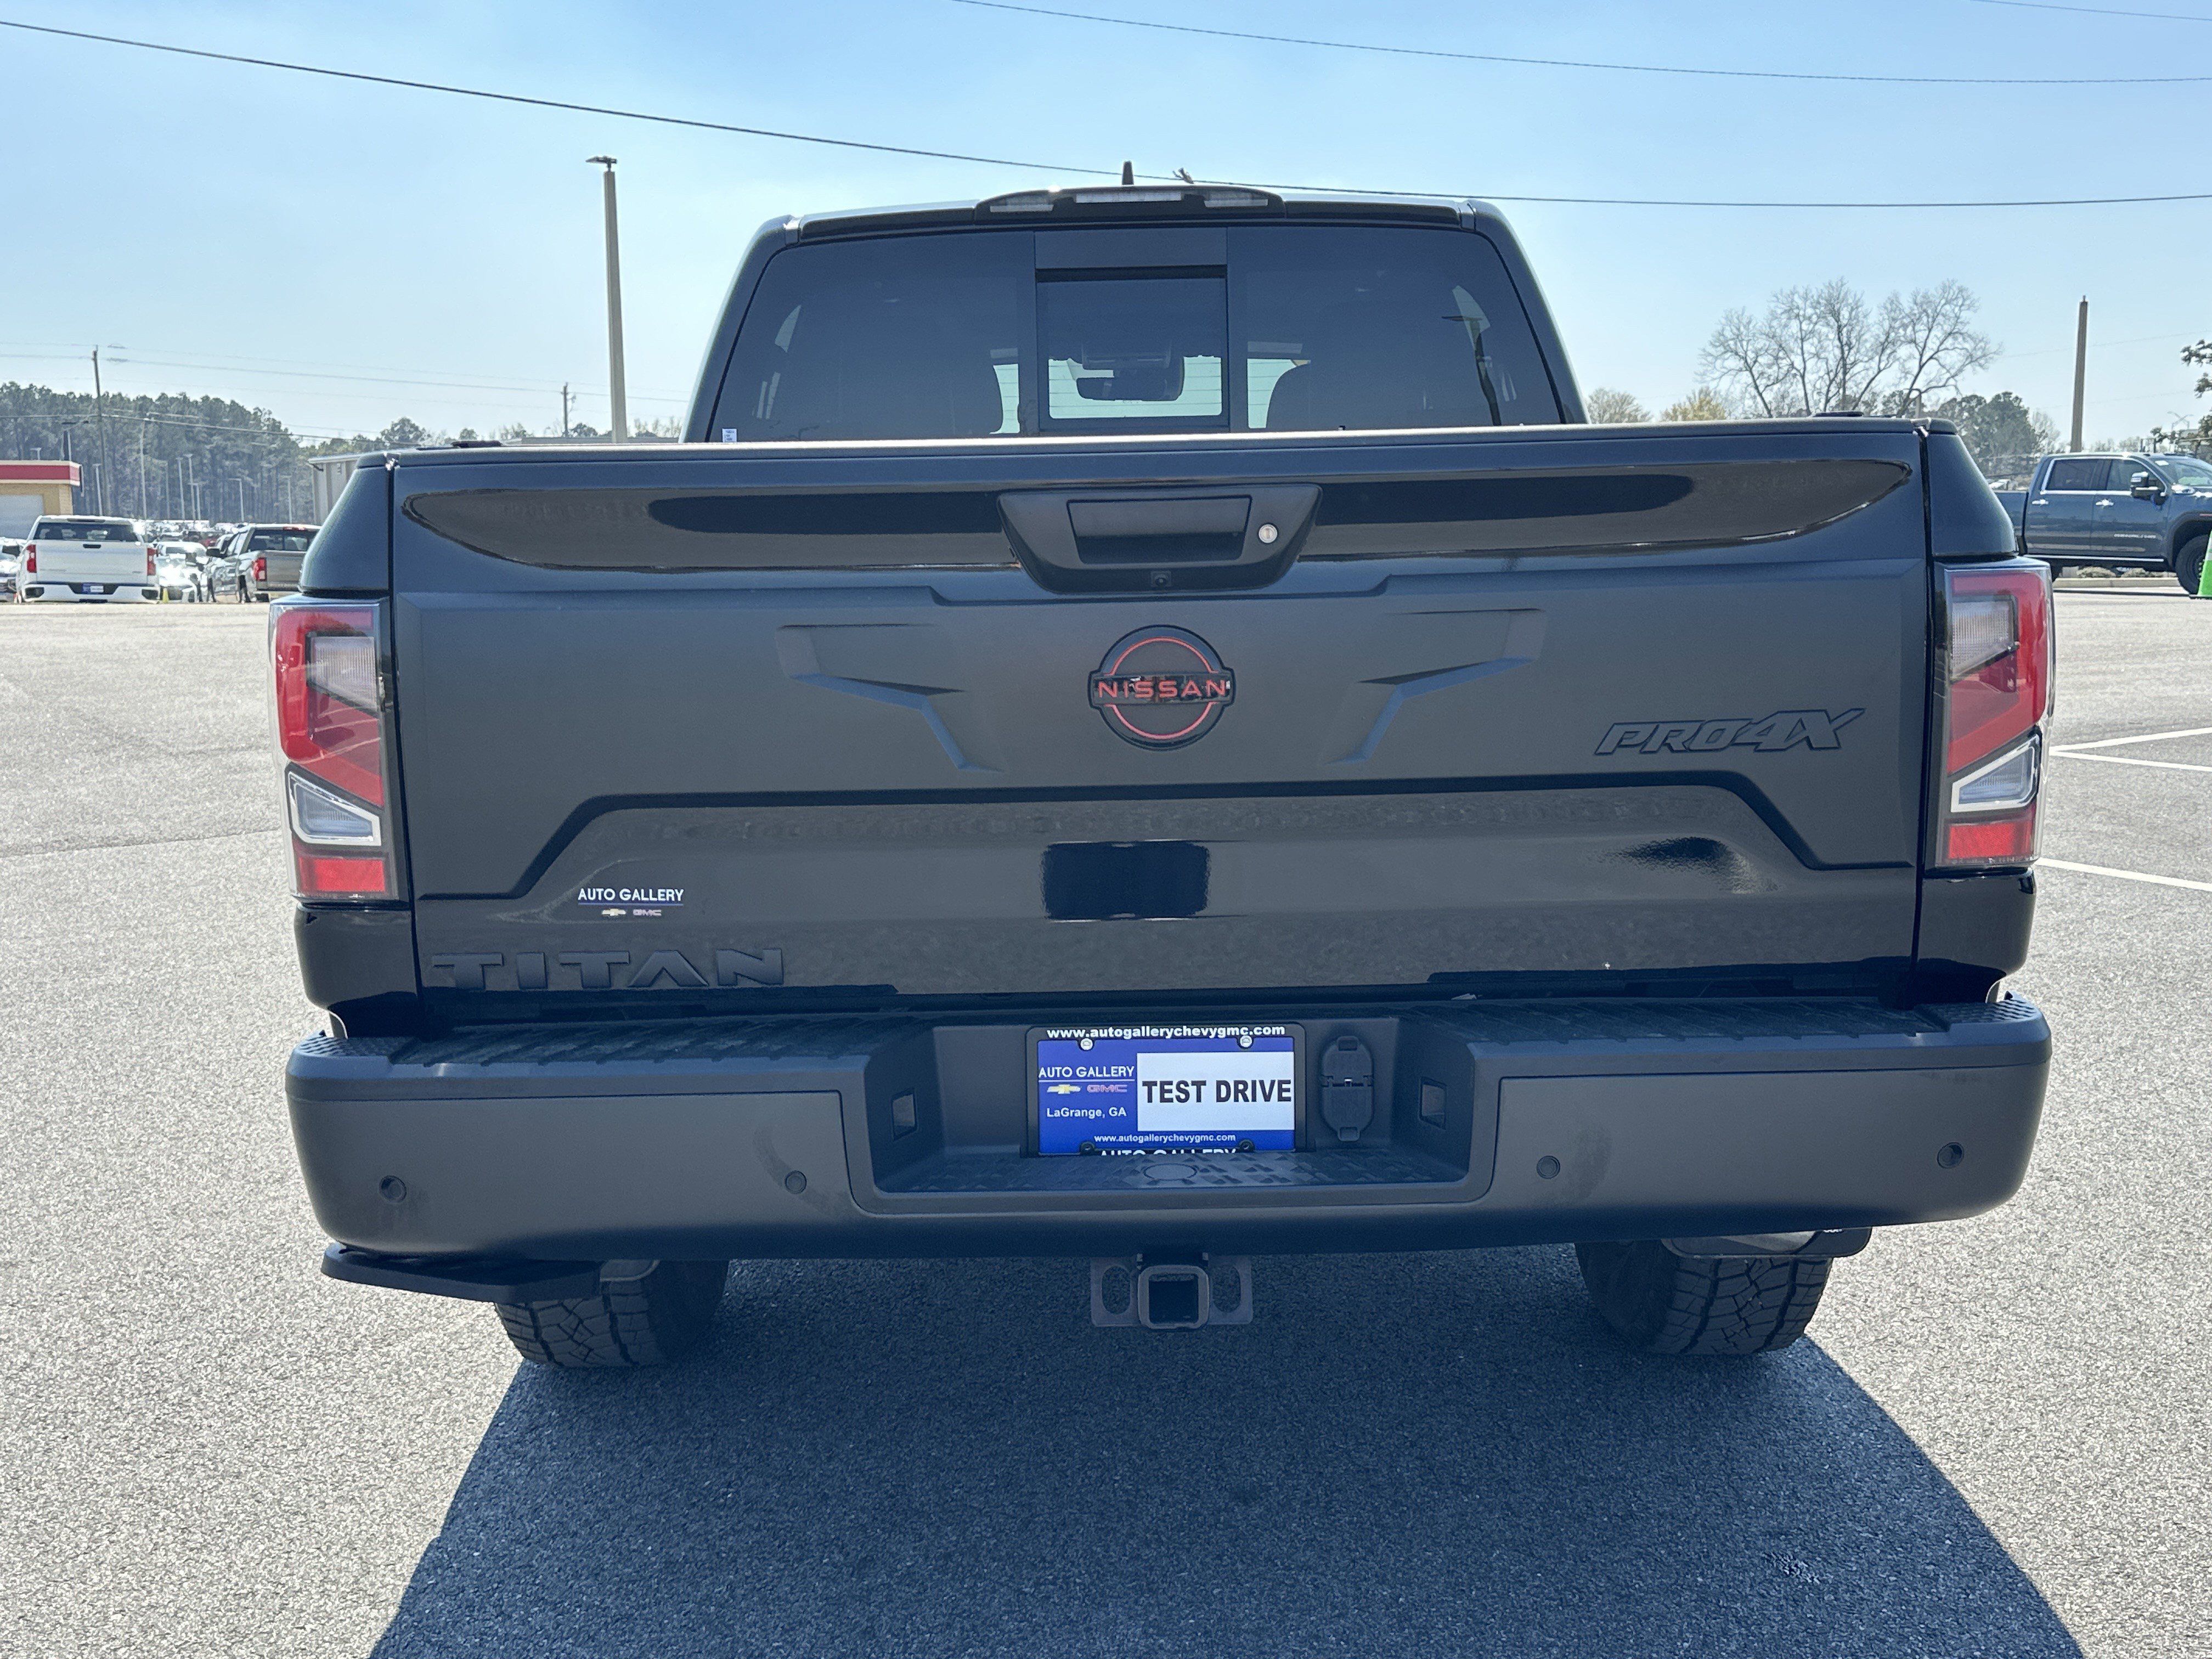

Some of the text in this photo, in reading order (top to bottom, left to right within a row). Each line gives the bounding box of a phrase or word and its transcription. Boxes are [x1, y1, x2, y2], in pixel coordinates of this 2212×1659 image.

[1098, 680, 1227, 698] NISSAN
[578, 888, 684, 901] AUTO GALLERY
[431, 948, 784, 990] TITAN
[1047, 1025, 1285, 1040] www.autogallerychevygmc.com
[1038, 1065, 1135, 1077] AUTO GALLERY
[1087, 1084, 1127, 1092] GMC
[1142, 1079, 1291, 1103] TEST DRIVE
[1046, 1107, 1126, 1119] LaGrange, GA
[1094, 1133, 1236, 1143] www.autogallerychevygmc.com
